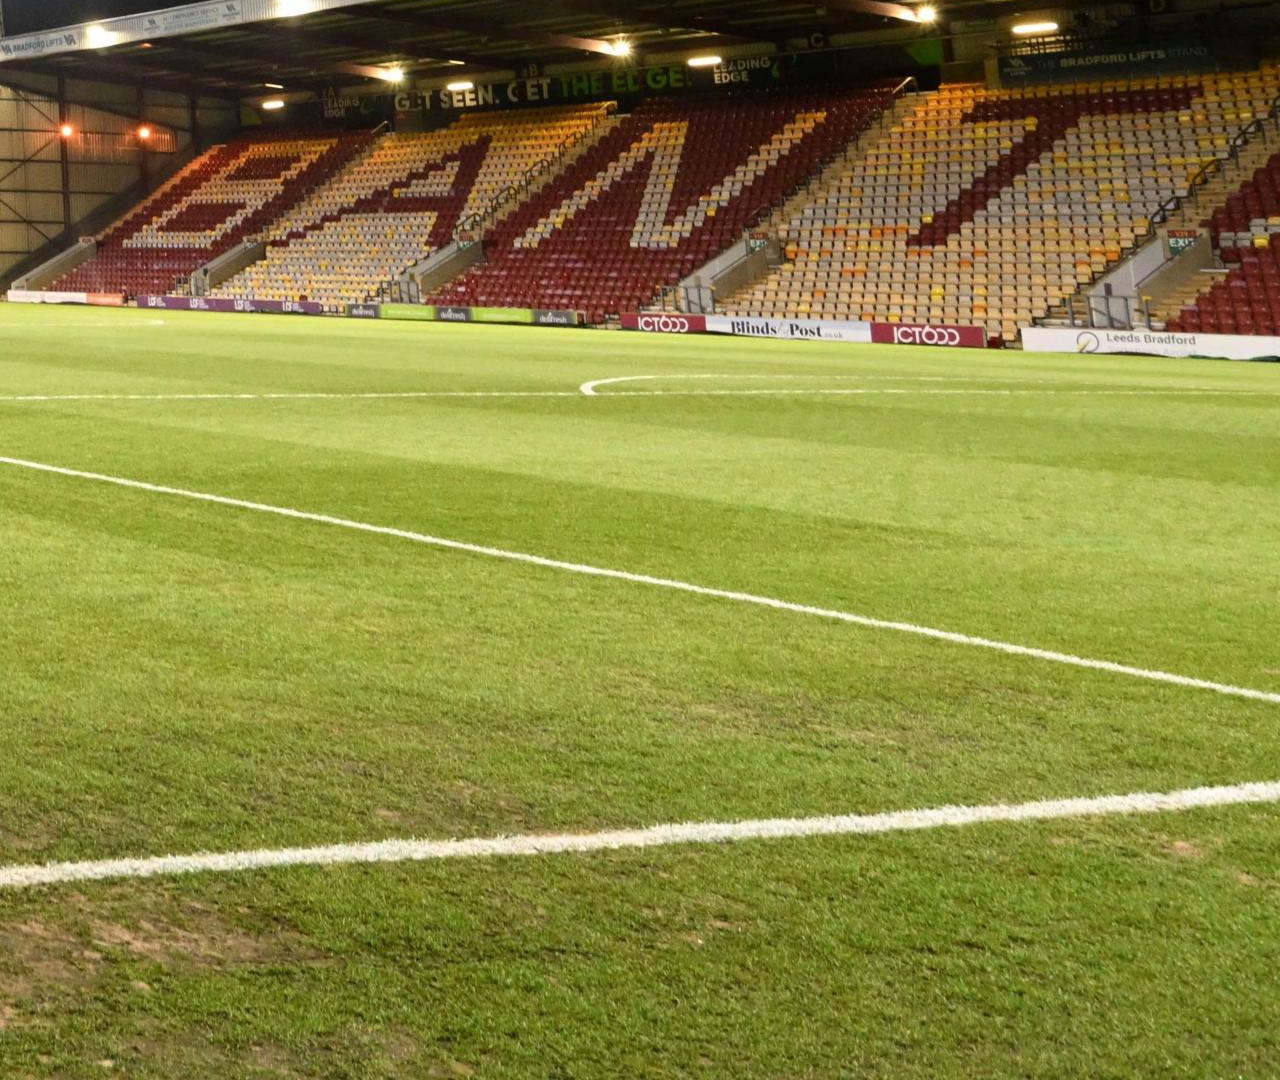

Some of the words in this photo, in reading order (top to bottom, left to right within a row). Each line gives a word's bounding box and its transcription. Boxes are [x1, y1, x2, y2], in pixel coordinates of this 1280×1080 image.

[13, 40, 45, 52] BRADFORD
[713, 57, 771, 73] LEADING
[1060, 53, 1127, 68] BRADFORD
[1128, 50, 1166, 62] LIFTS
[1168, 46, 1207, 58] STAND
[560, 70, 603, 97] THE
[714, 72, 749, 85] EDGE
[120, 85, 1280, 252] BANT
[1169, 238, 1194, 247] EXIT
[730, 321, 777, 335] Blinds
[790, 323, 822, 338] Post
[1106, 333, 1140, 344] Leeds
[1143, 334, 1196, 345] Bradford
